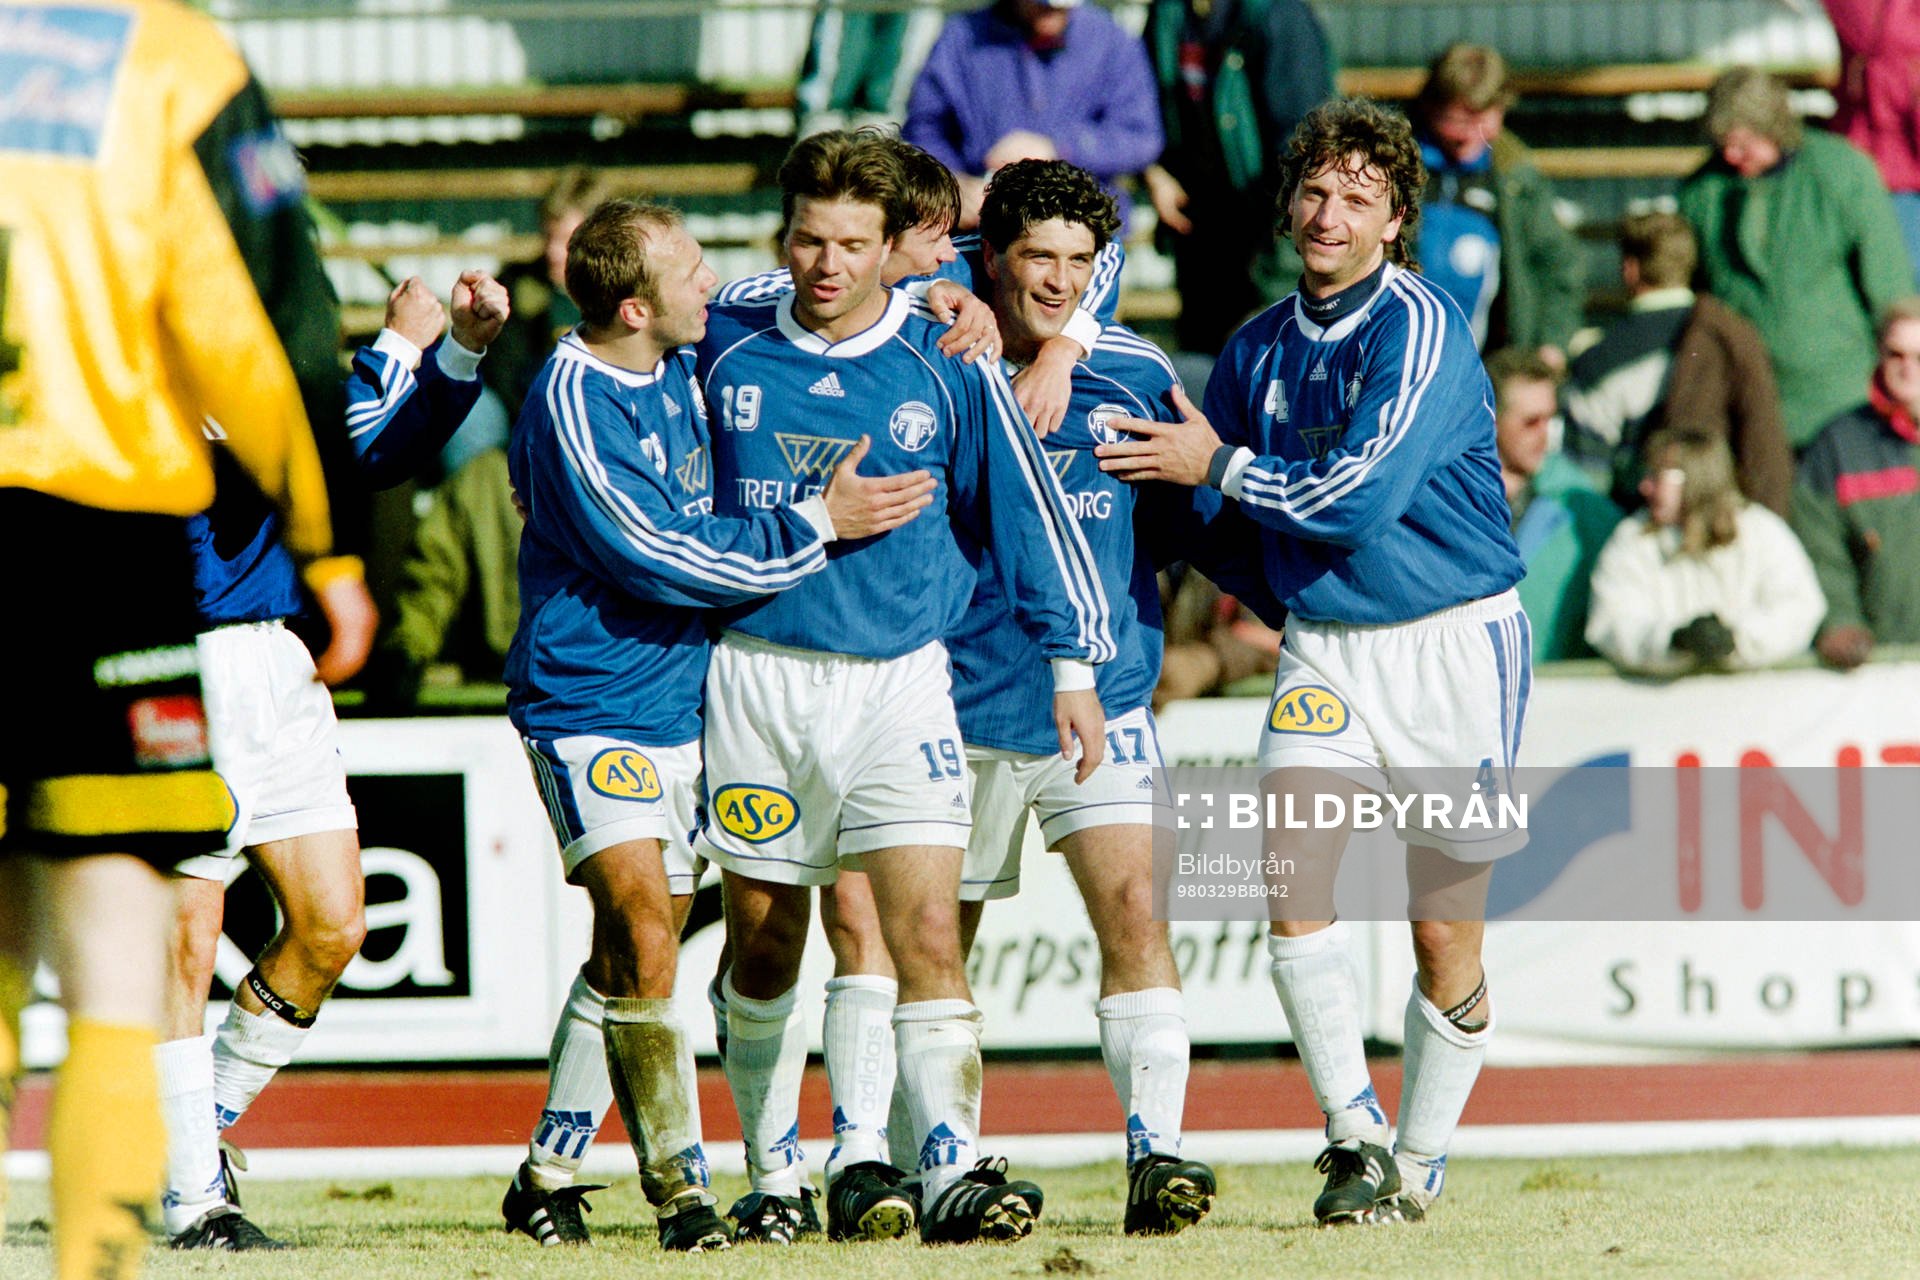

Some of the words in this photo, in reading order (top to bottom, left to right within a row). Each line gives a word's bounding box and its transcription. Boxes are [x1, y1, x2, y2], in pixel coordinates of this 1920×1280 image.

[721, 384, 762, 432] 19
[808, 385, 846, 398] adidas
[1264, 380, 1289, 423] 4
[735, 478, 825, 509] TRELLE
[1278, 692, 1334, 726] ASG
[919, 738, 964, 782] 19
[1105, 727, 1150, 766] 17
[606, 754, 655, 794] ASG
[725, 793, 783, 835] ASG
[1608, 956, 1920, 1029] Shop
[858, 1024, 884, 1113] adidas
